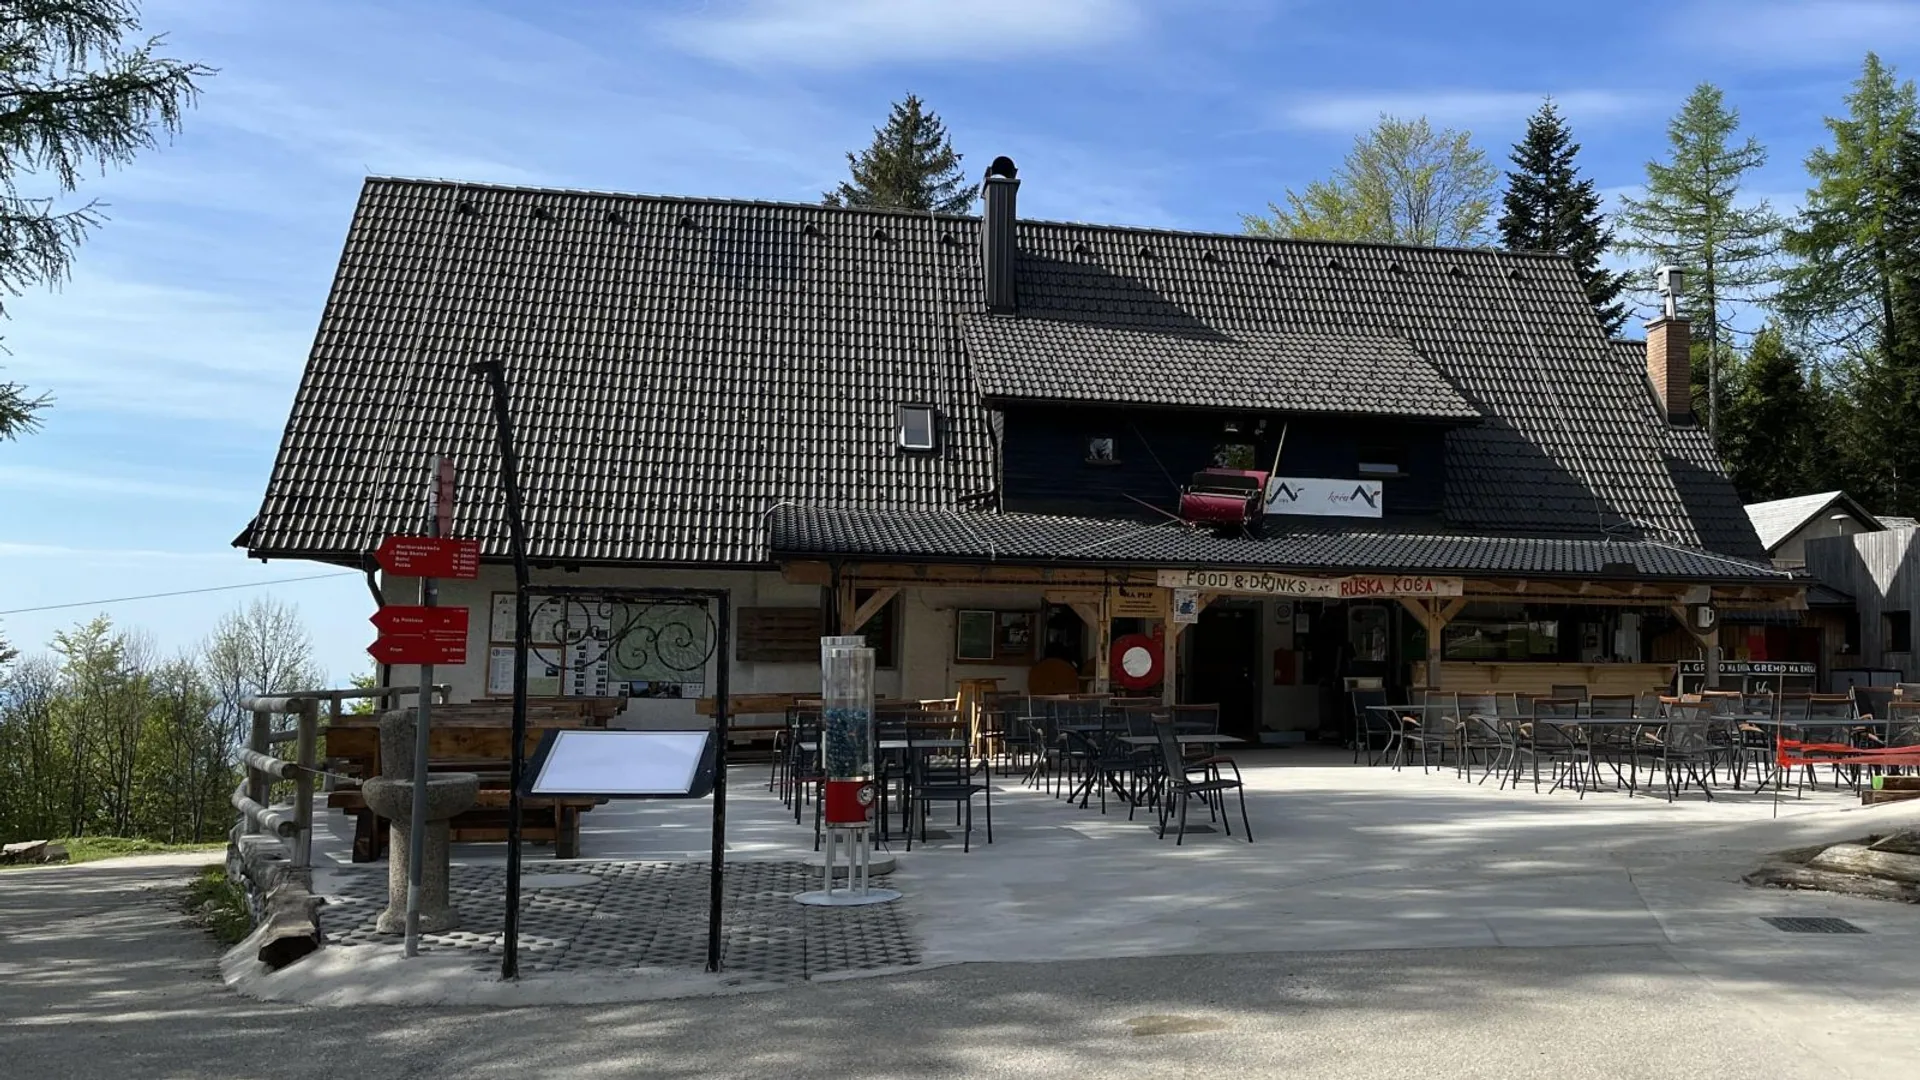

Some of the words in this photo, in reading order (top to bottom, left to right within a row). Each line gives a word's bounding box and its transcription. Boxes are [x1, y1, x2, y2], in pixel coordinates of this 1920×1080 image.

[1186, 570, 1228, 587] FOOD
[1234, 574, 1244, 588] &
[1249, 574, 1308, 593] DRINKS
[1340, 577, 1386, 597] RUŠKA
[1392, 575, 1434, 593] KOČA
[1683, 663, 1690, 672] A
[1754, 664, 1787, 673] GREMO
[1789, 664, 1798, 673] NA
